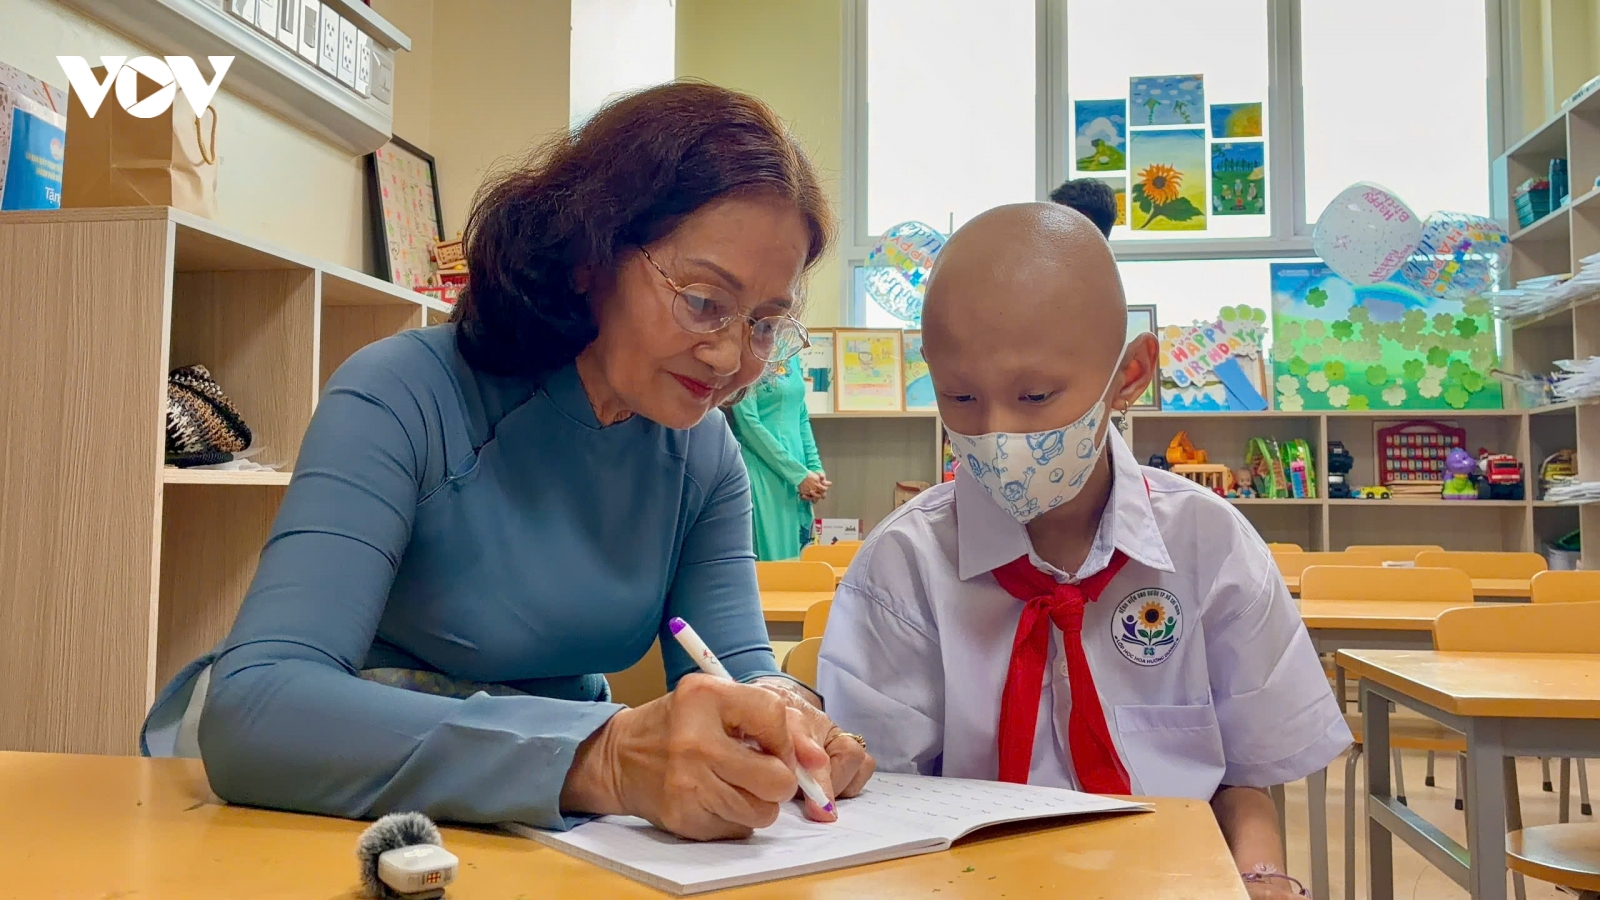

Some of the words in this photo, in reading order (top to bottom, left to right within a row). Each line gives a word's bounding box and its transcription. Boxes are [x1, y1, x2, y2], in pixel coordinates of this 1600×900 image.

[45, 186, 61, 206] Tặn
[889, 235, 933, 269] APPY
[1171, 320, 1226, 362] HAPPY
